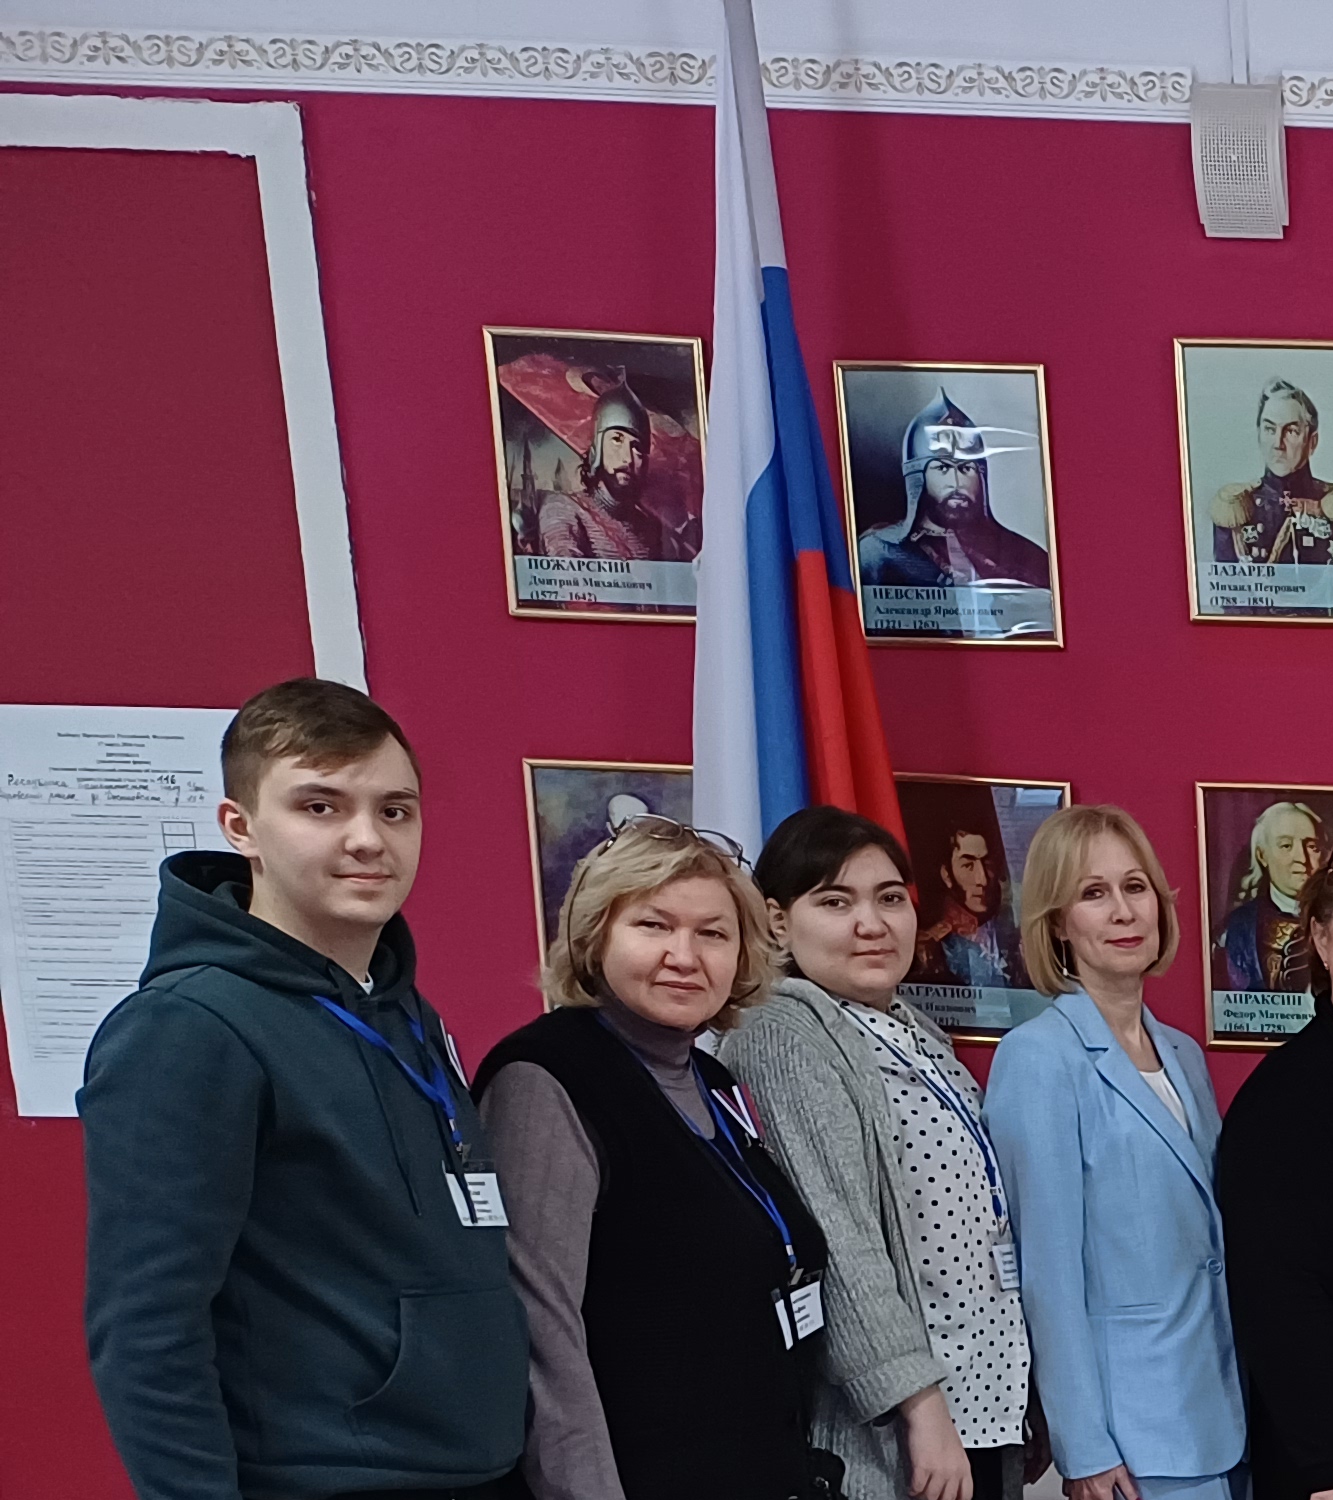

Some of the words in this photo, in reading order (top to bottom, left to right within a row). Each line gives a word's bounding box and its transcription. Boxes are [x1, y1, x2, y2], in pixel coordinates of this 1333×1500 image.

[527, 558, 631, 574] ПОЖАРСКИЙ
[1208, 565, 1275, 577] ЛАЗАРЕВ
[528, 575, 579, 588] Дмитрий
[583, 578, 652, 590] Михайлович
[1210, 582, 1252, 592] Михаил
[1254, 583, 1306, 594] Петрович
[873, 587, 947, 601] НЕВСКИЙ
[875, 606, 932, 617] Александр
[896, 985, 982, 1000] БАГРАТИОН
[1223, 994, 1302, 1006] АПРАКСИН
[1223, 1009, 1256, 1021] Федор
[1258, 1010, 1314, 1020] Матвеевич
